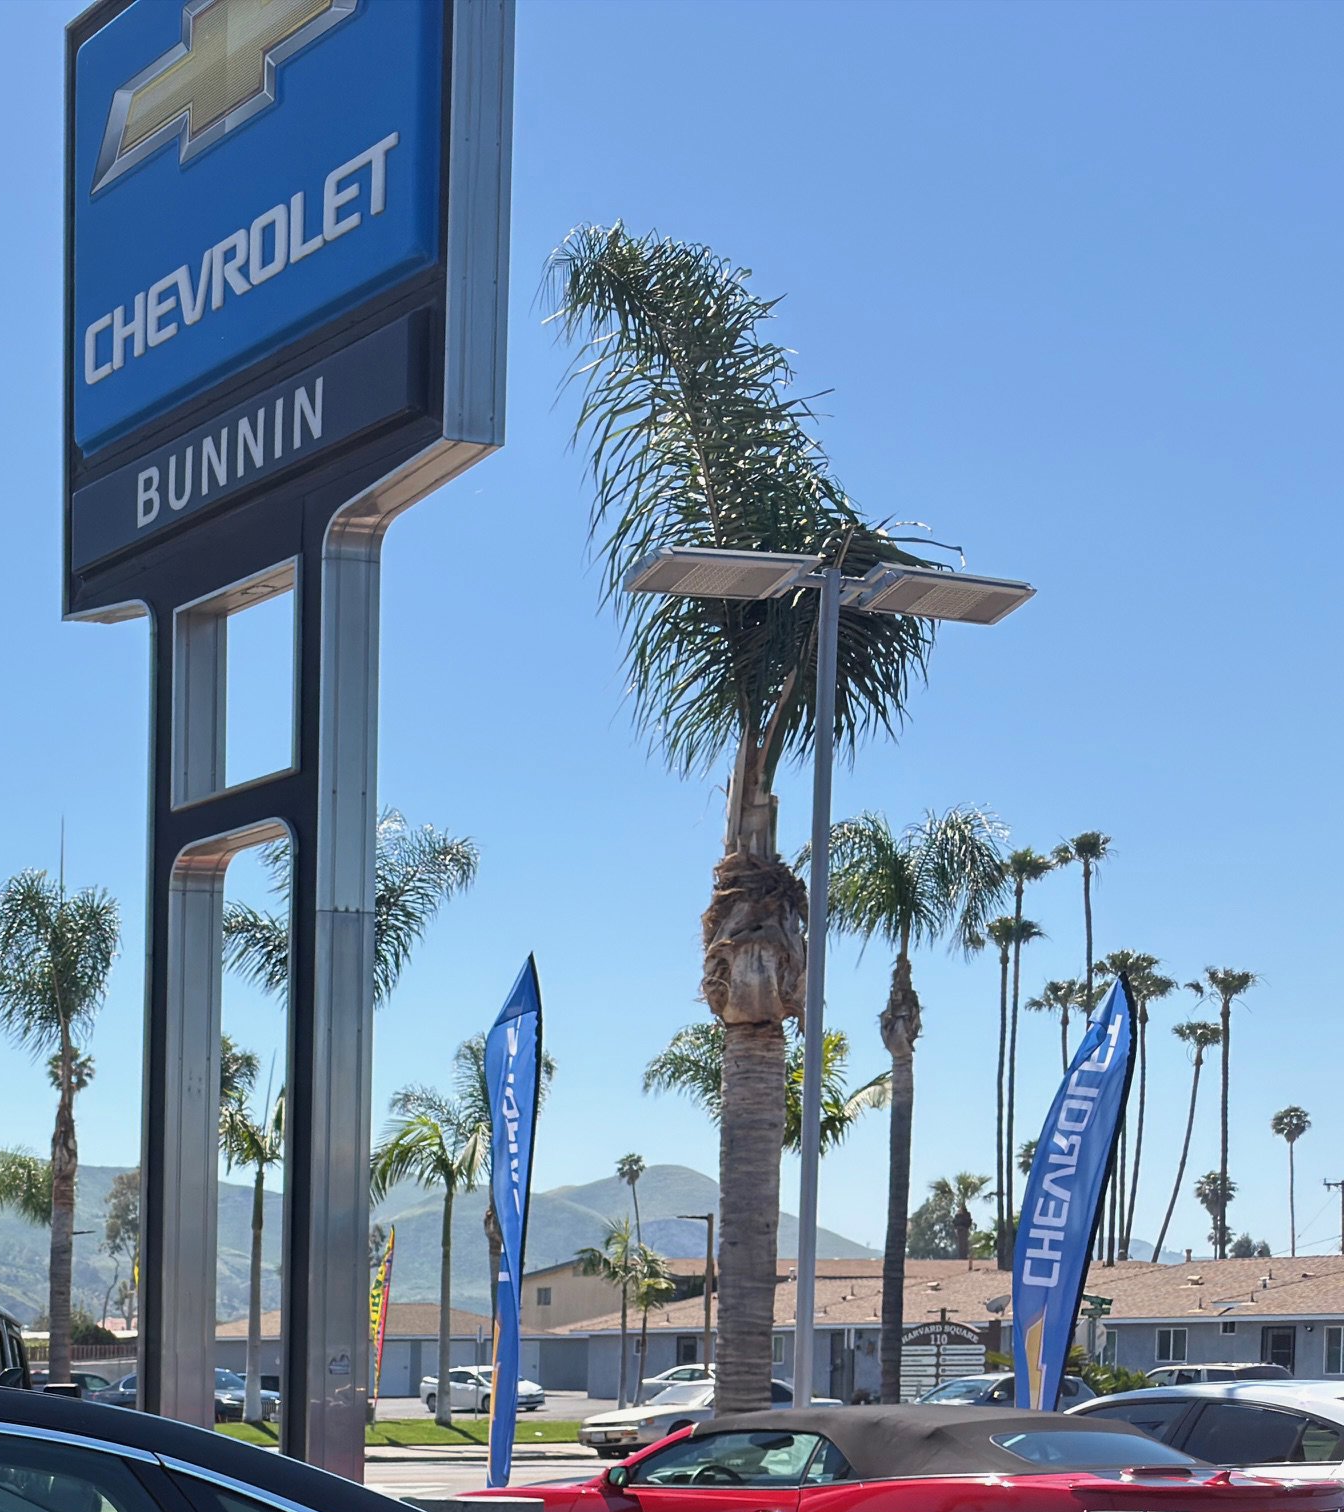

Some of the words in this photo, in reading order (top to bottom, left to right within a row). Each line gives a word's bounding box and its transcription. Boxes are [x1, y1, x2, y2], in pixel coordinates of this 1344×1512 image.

[84, 132, 399, 385] CHEVROLET
[137, 377, 323, 528] BUNNIN
[901, 1325, 943, 1344] HARVARD
[944, 1325, 979, 1343] SQUARE
[930, 1334, 948, 1345] 110
